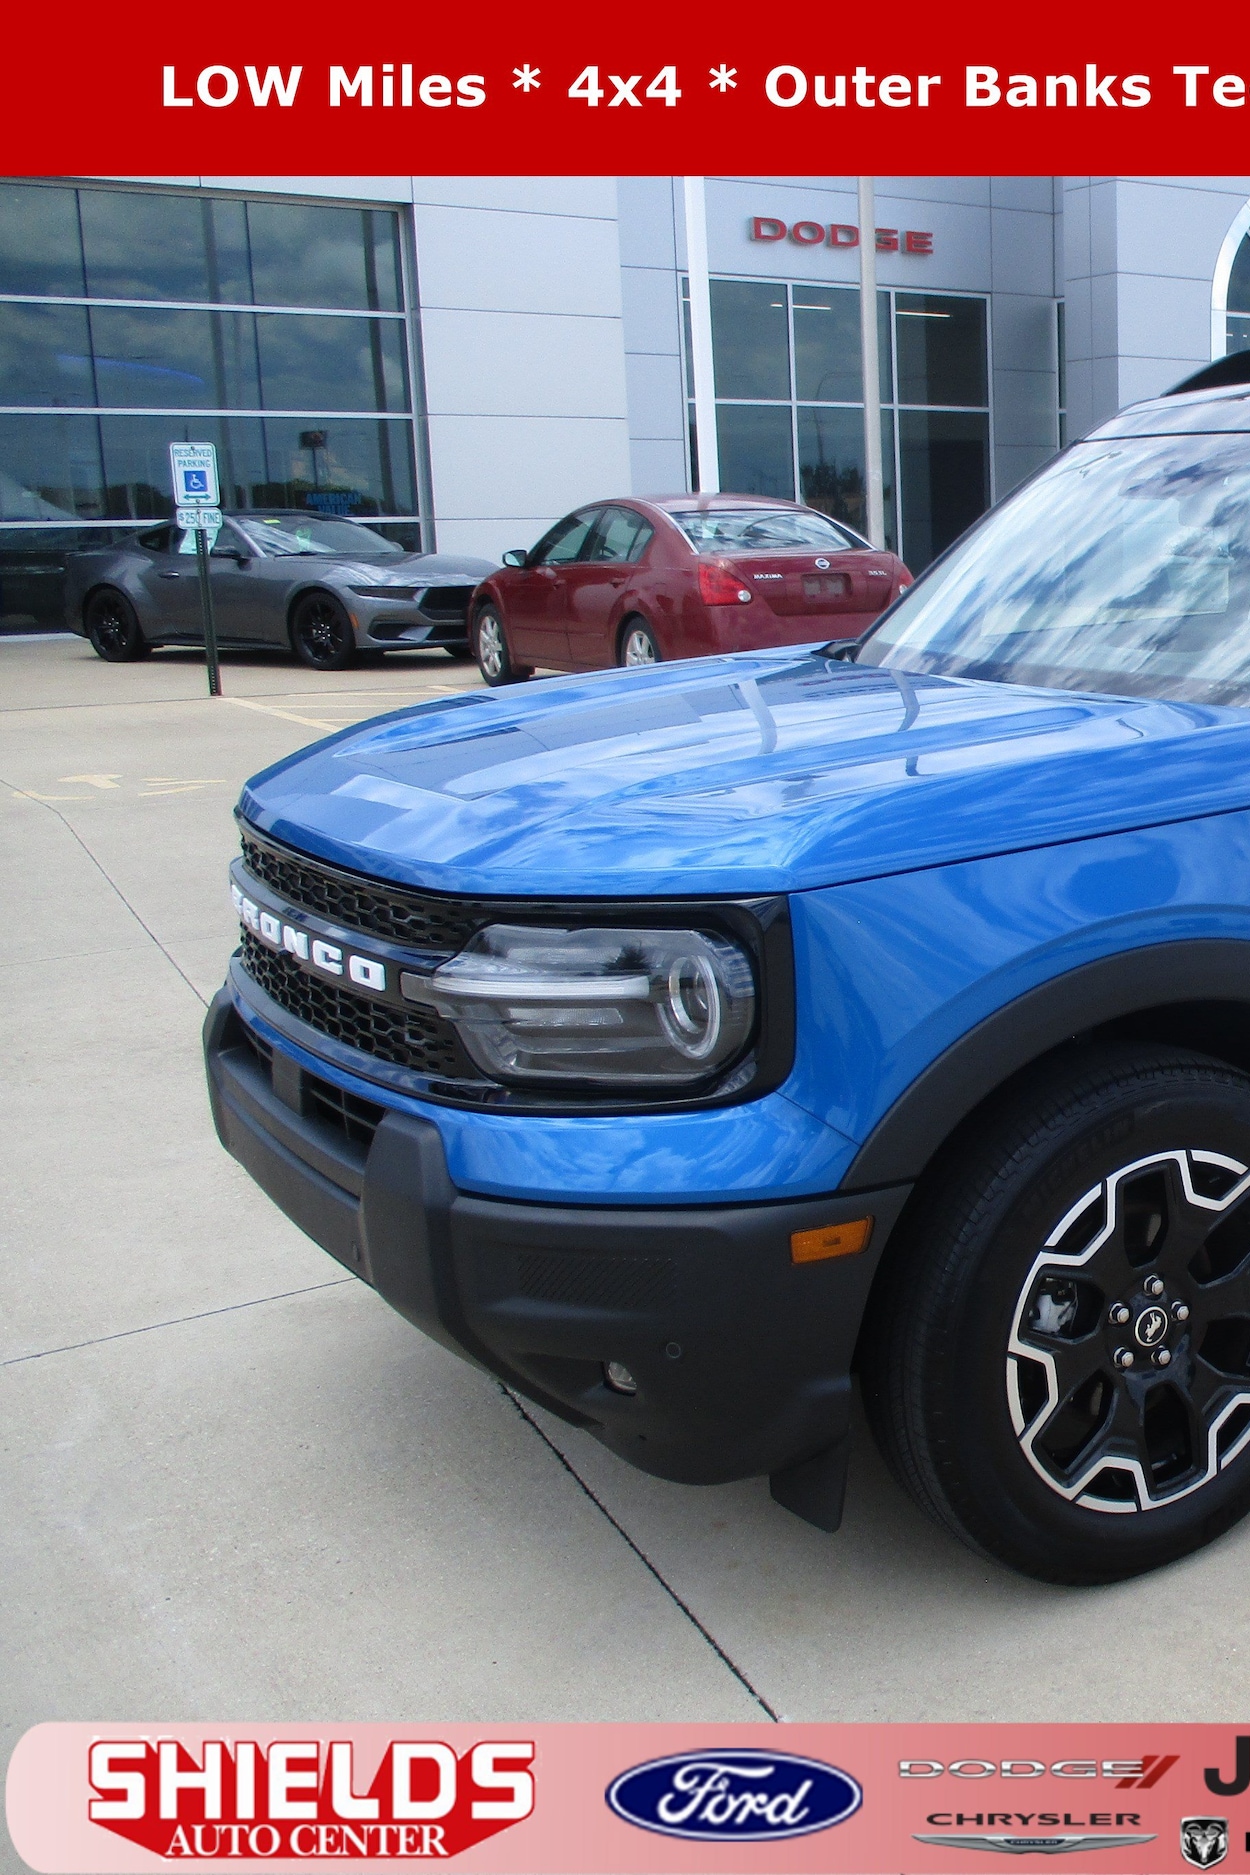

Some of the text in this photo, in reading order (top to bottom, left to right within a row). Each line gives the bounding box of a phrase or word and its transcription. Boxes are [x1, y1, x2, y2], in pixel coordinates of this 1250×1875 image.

[752, 216, 934, 254] DODGE
[174, 448, 212, 458] RESERVED
[178, 459, 211, 468] PARKING
[203, 512, 220, 524] FINE
[231, 884, 386, 992] BRONCO
